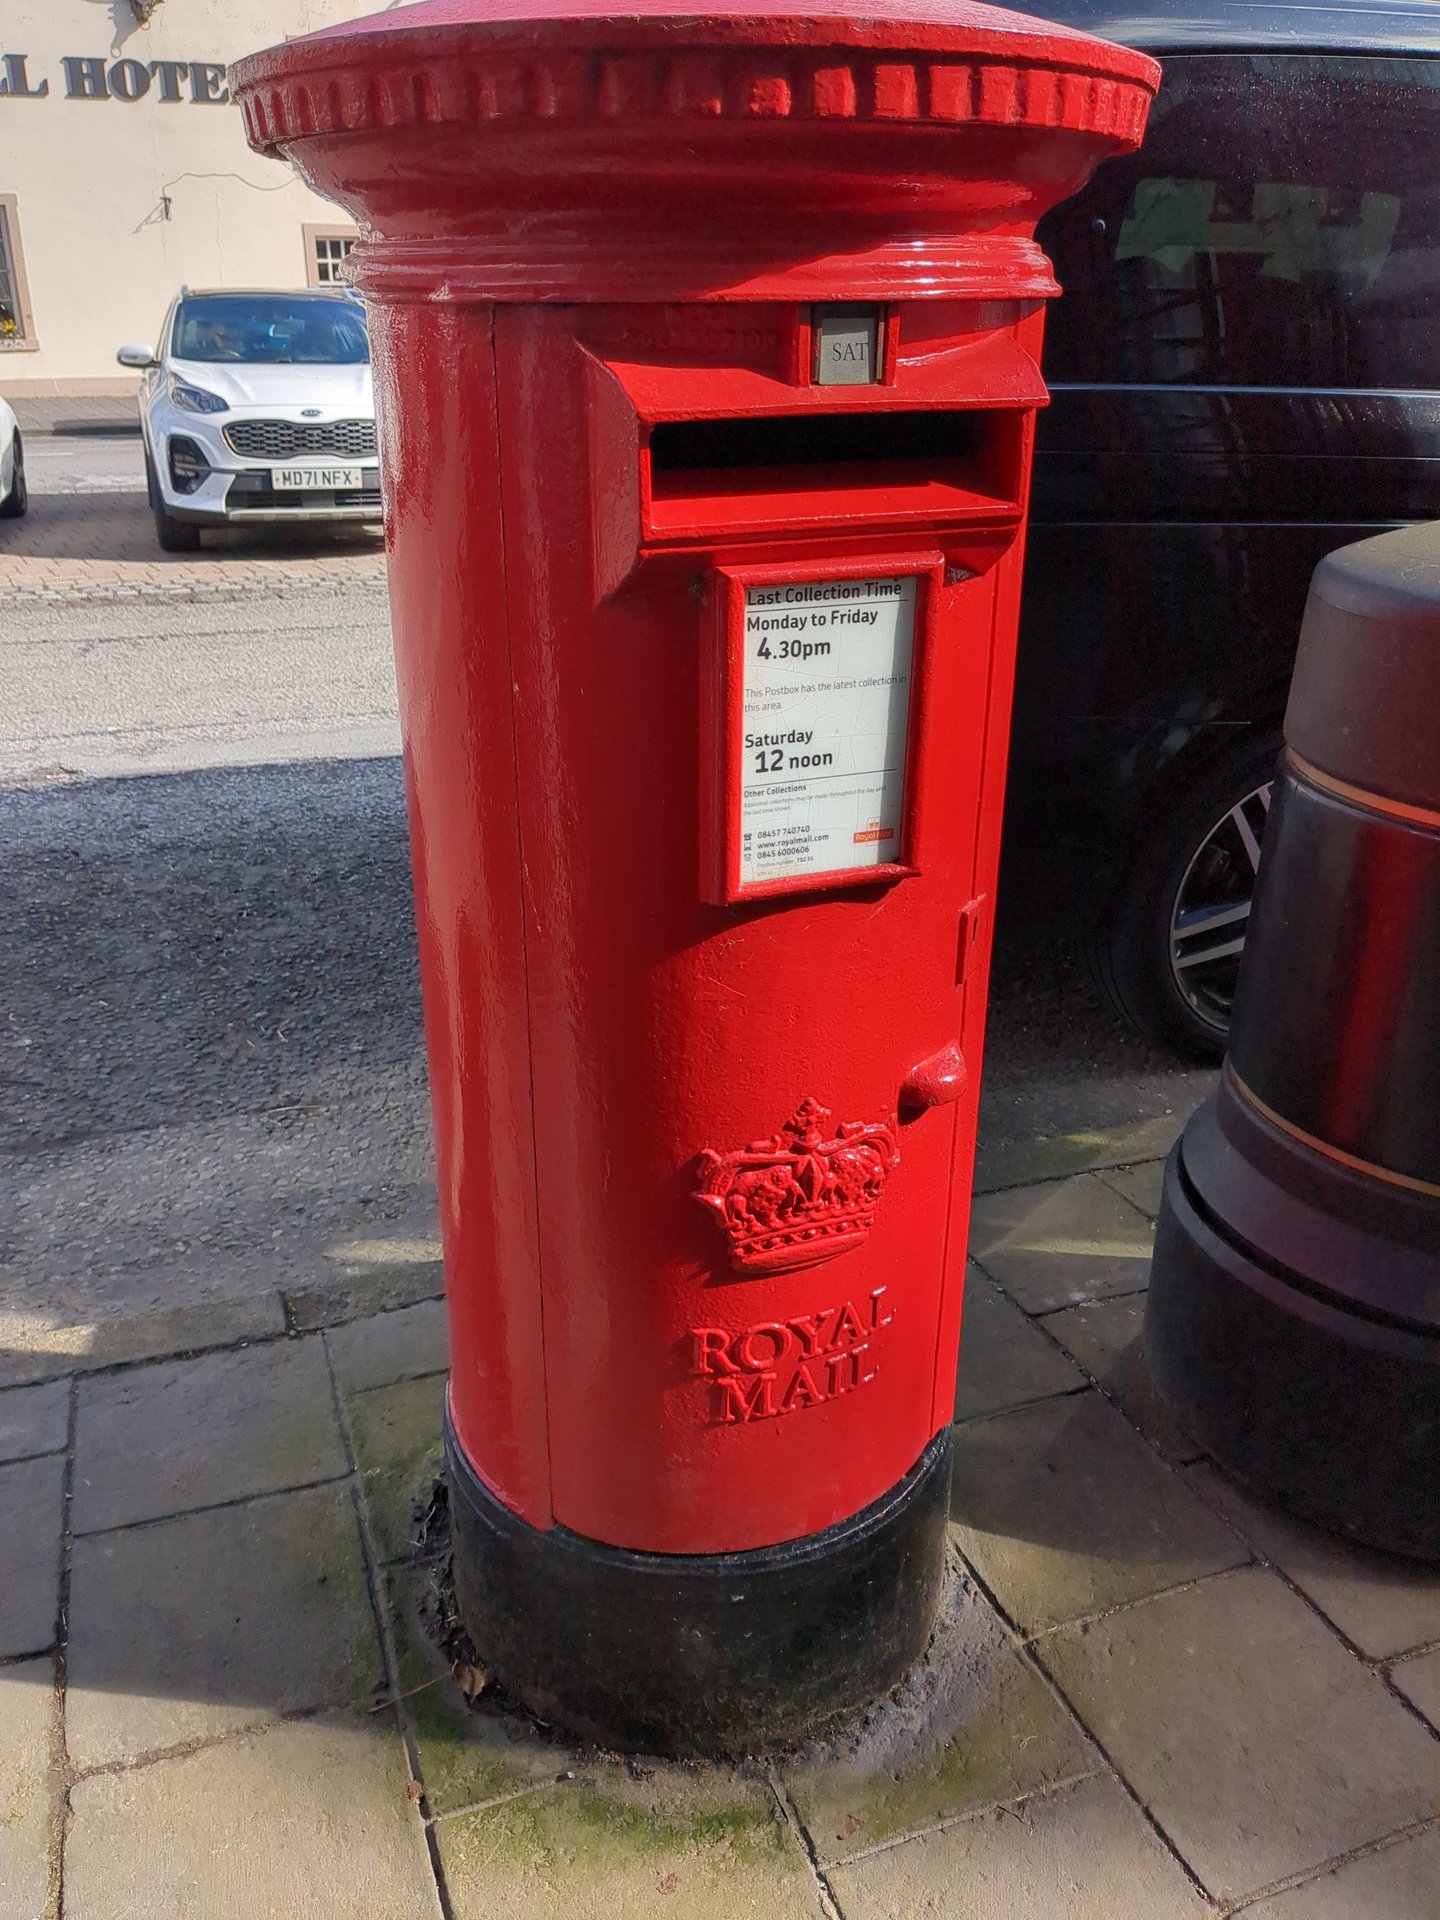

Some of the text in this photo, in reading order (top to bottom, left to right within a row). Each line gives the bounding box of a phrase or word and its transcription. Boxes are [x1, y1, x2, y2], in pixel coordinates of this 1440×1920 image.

[0, 54, 241, 105] L HOTE
[832, 342, 869, 361] SAT
[282, 471, 352, 486] MD71 NFX
[748, 582, 902, 606] Last Collection Time
[747, 609, 878, 632] Monday to Friday
[757, 637, 831, 660] 4.30pm
[746, 675, 907, 698] This Postbox has the latest collection in
[745, 702, 784, 713] this area.
[745, 730, 813, 749] Saturday
[755, 749, 833, 773] 12 noon
[744, 784, 807, 798] Other Collections
[757, 825, 811, 839] 08457 740740
[757, 834, 830, 849] www.royalmail.com
[855, 831, 876, 842] Royal
[757, 846, 810, 860] 0845 6000606
[690, 1286, 897, 1374] ROYAL
[716, 1343, 880, 1423] MAIL
